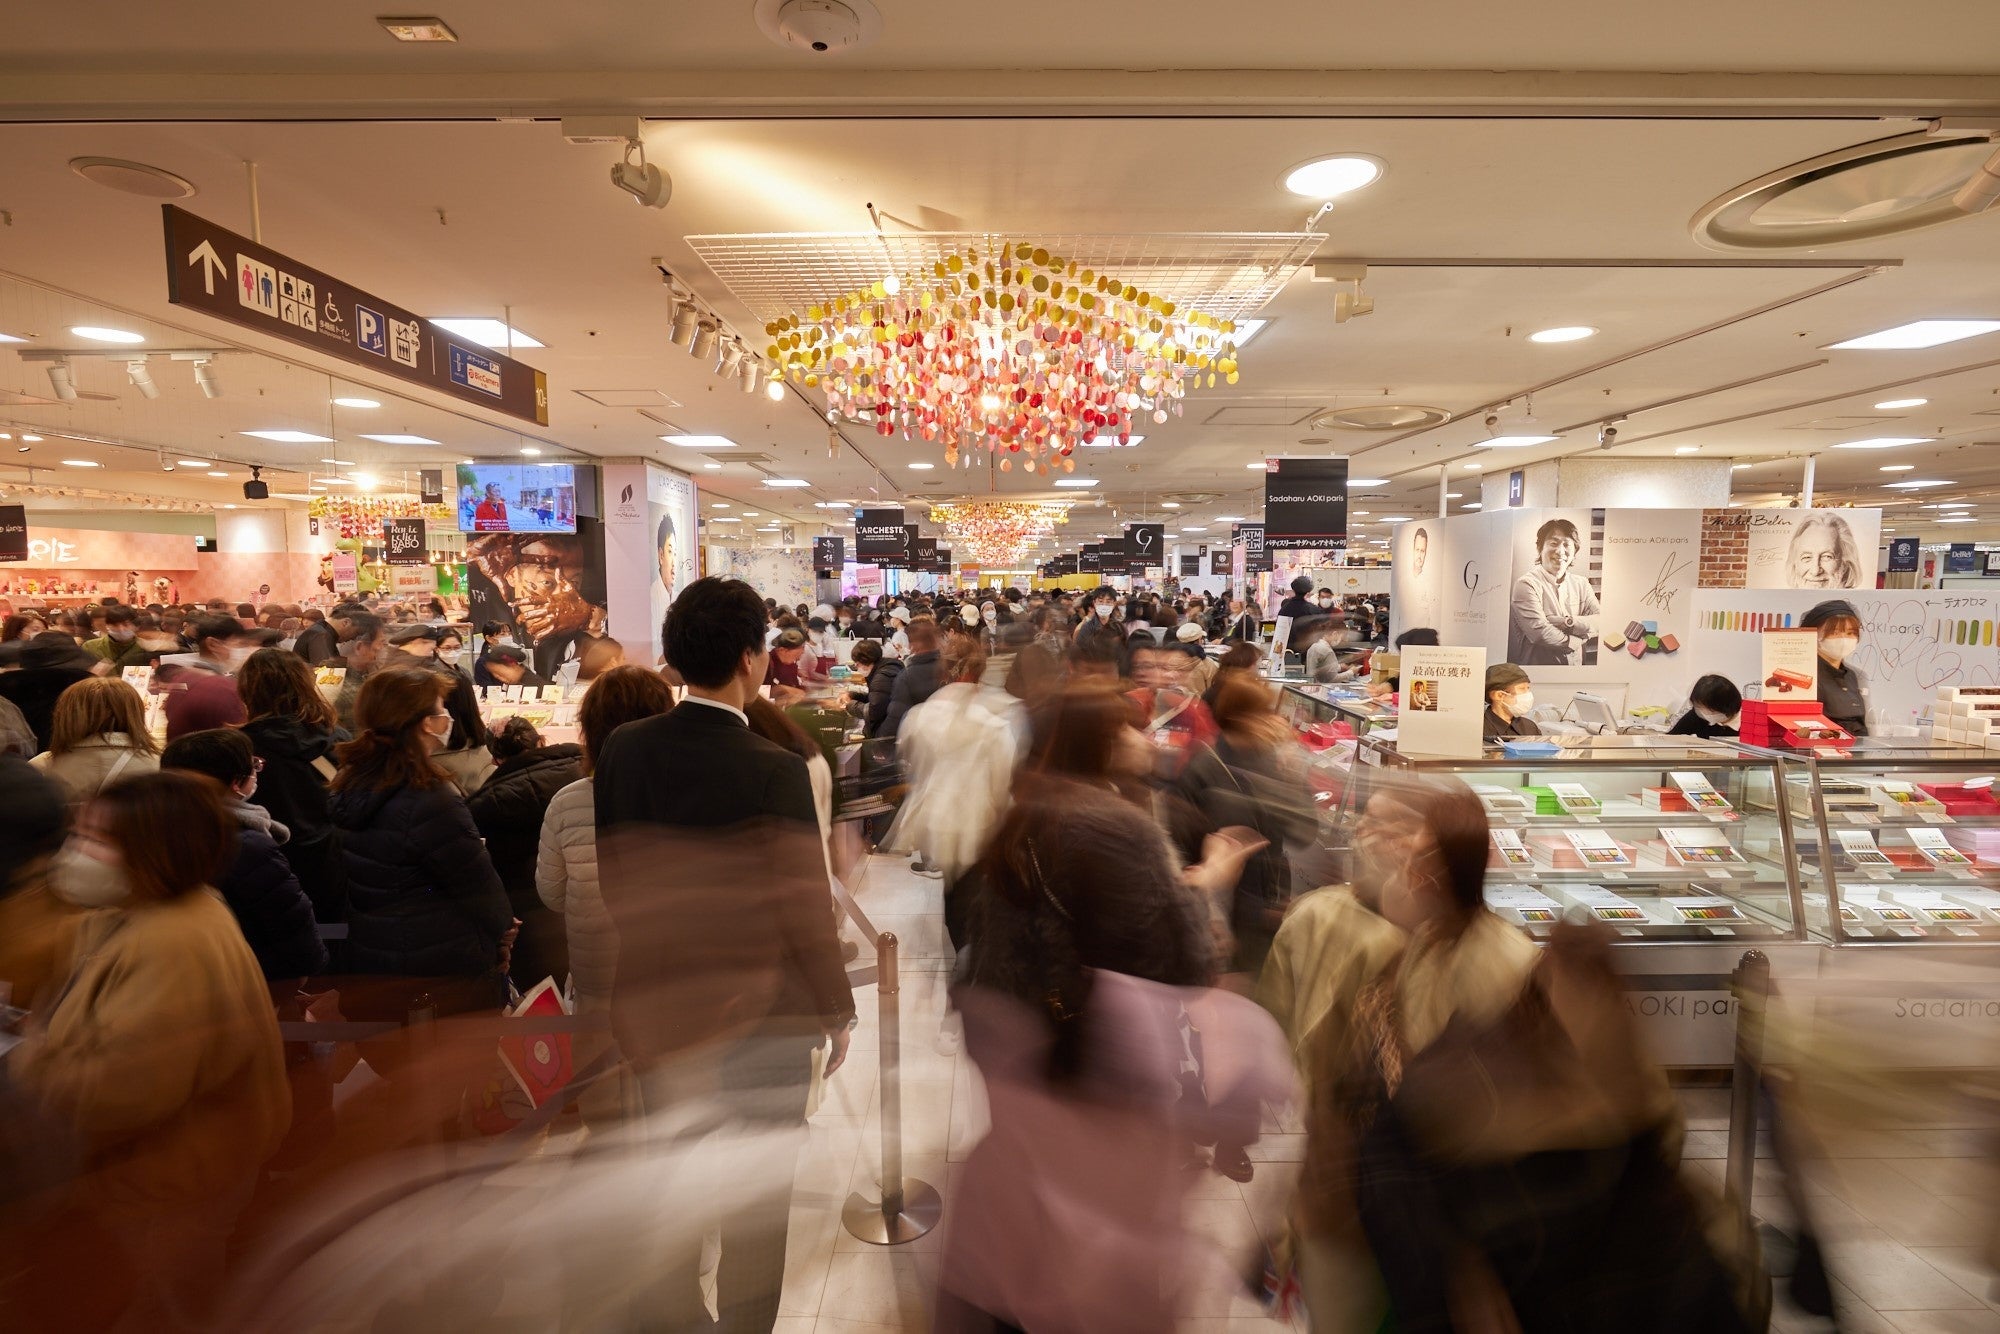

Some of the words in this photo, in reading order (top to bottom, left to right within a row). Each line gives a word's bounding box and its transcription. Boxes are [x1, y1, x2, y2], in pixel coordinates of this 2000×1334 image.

[360, 310, 377, 343] P
[425, 477, 438, 496] L
[1510, 478, 1521, 498] H
[1269, 494, 1305, 502] Sadaharu
[1306, 494, 1325, 502] AOKI
[1326, 494, 1344, 503] paris
[311, 521, 318, 532] P
[1751, 514, 1792, 527] Belin
[783, 529, 793, 541] K
[856, 526, 904, 535] L'ARCHESTE
[1608, 536, 1647, 544] Sadaharu
[1649, 536, 1668, 544] AOKI
[1670, 536, 1689, 545] paris
[1200, 547, 1206, 555] F
[1889, 624, 1920, 635] paris
[1412, 665, 1471, 678] 最高位獲得
[1692, 999, 1738, 1020] par
